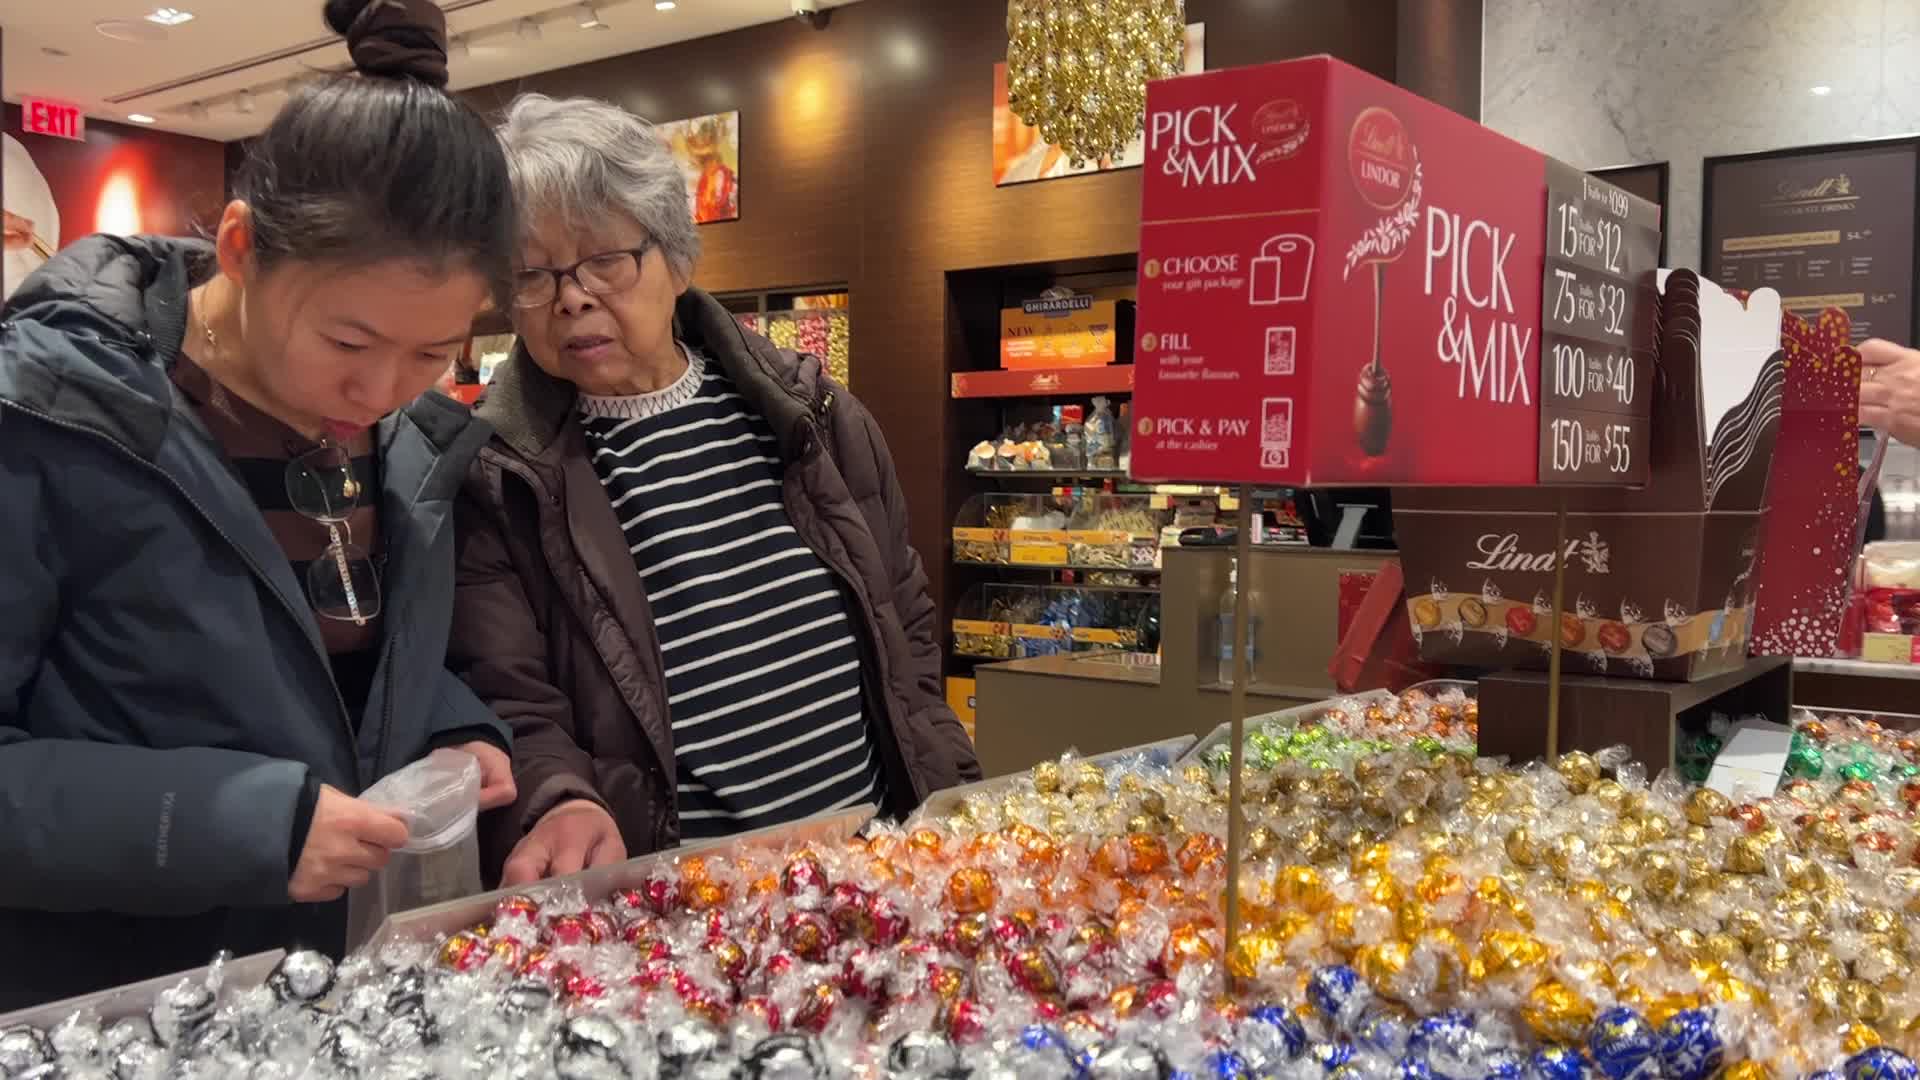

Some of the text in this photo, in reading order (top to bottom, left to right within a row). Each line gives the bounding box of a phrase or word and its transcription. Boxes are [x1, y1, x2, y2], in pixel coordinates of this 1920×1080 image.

[31, 101, 79, 138] EXIT
[1151, 103, 1238, 150] PICK
[1361, 159, 1401, 189] LINDOR
[1559, 202, 1622, 274] 15 FOR $12
[1163, 254, 1239, 275] CHOOSE
[1424, 205, 1516, 314] PICK
[1025, 298, 1090, 313] GHIRARDELLI
[1553, 267, 1626, 336] 75 FOR $32
[1008, 326, 1034, 337] NEW
[1160, 332, 1192, 351] FILL
[1552, 343, 1635, 405] 100 FOR $40
[1157, 417, 1196, 436] PICK
[1199, 419, 1213, 436] &
[1218, 418, 1250, 437] PAY
[1551, 417, 1632, 473] 150 FOR $55
